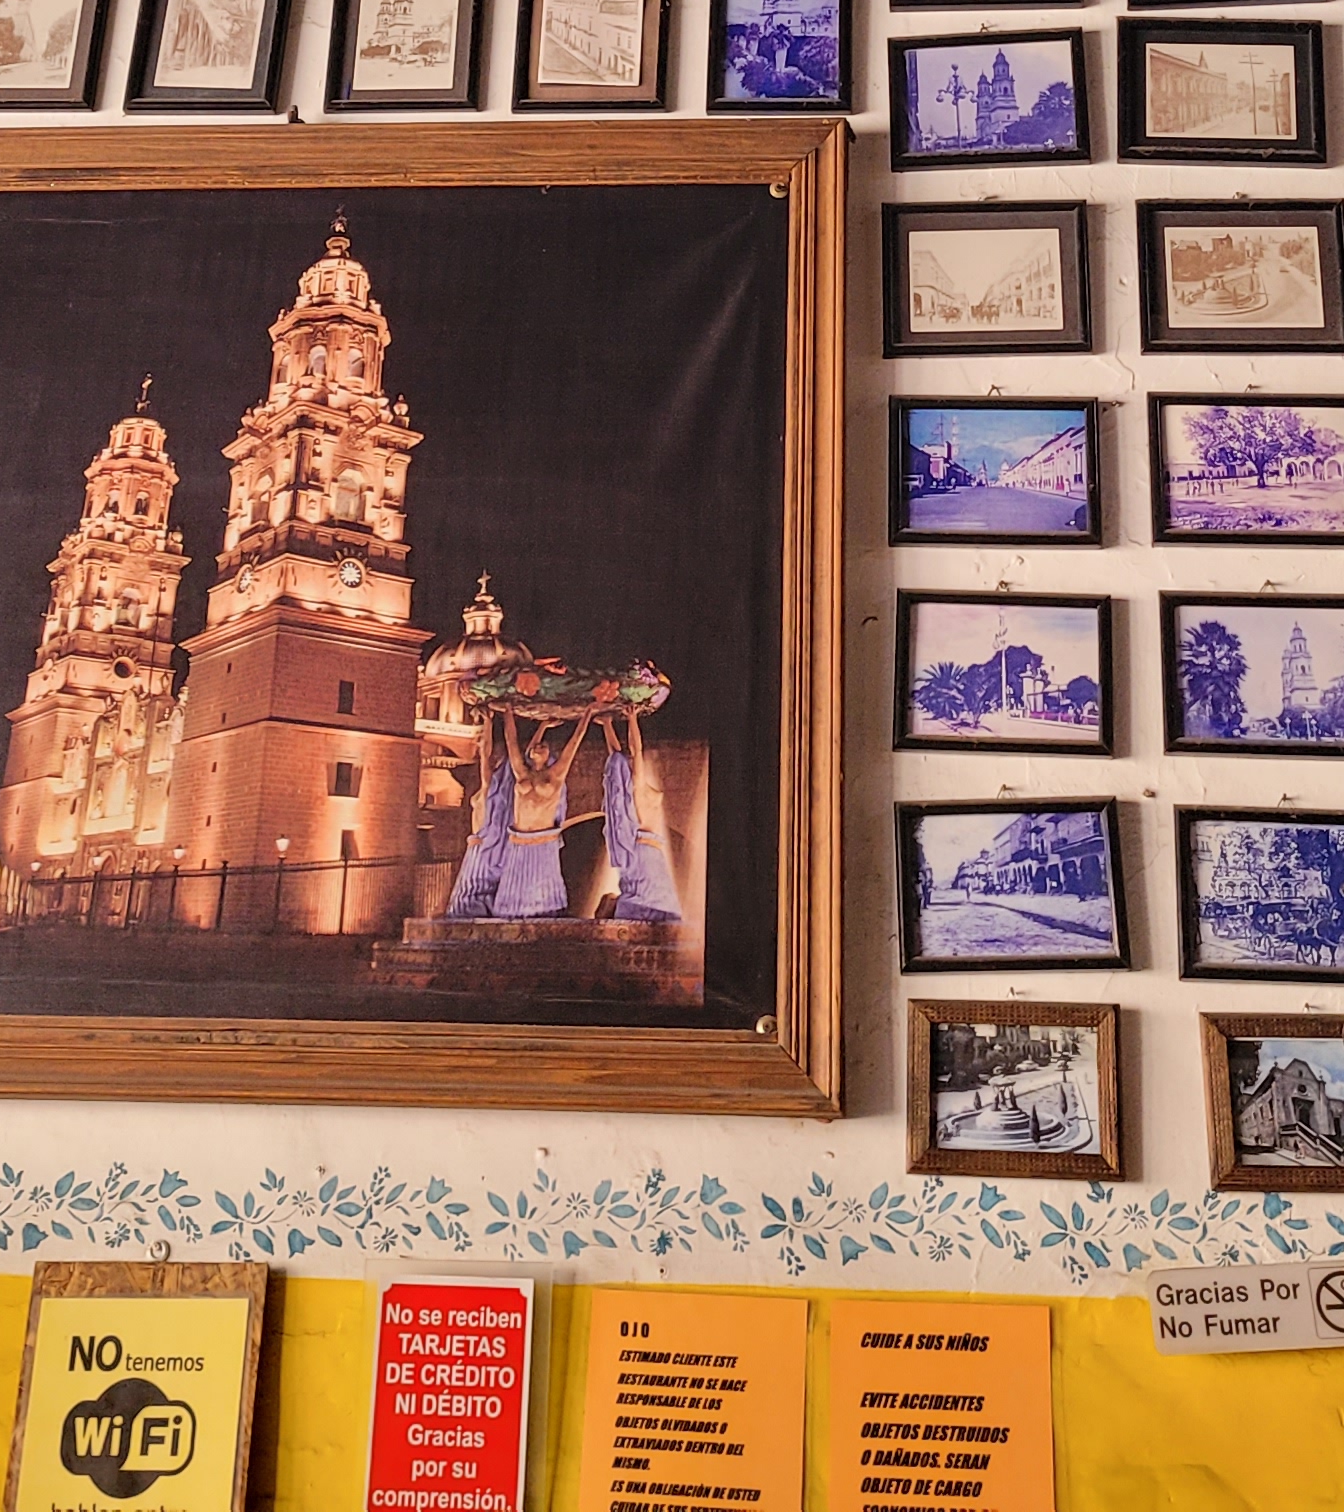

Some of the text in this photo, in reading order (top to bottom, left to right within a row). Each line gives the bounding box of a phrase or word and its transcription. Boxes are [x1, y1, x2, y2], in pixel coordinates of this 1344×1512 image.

[1156, 1279, 1300, 1306] Gracias Por
[385, 1303, 522, 1329] No se reciben
[1159, 1314, 1281, 1339] No Fumar
[398, 1333, 506, 1359] TARJETAS
[860, 1332, 990, 1352] CUIDE A SUS NIÑOS
[68, 1335, 205, 1372] NO tenemos
[619, 1350, 738, 1368] ESTIMADO CLIENTE ESTE
[385, 1359, 515, 1389] DE CRÉDITO
[617, 1373, 748, 1392] RESTAURANTE NO SE HACE
[395, 1389, 502, 1418] NI DÉBITO
[616, 1392, 723, 1411] RESPONSABLE DE LOS
[860, 1392, 985, 1412] EVITE ACCIDENTES
[407, 1423, 485, 1448] Gracias
[615, 1416, 728, 1434] OBJETOS OLVIDADOS O
[860, 1422, 1010, 1444] OBJETOS DESTRUIDOS
[613, 1436, 745, 1456] EXTRAVIADOS DENTRO DEL
[411, 1458, 477, 1481] por su
[611, 1456, 651, 1470] MISMO.
[860, 1447, 991, 1470] O DAÑADOS. SERAN
[610, 1480, 761, 1502] ES UNA OBLIGACIÓN DE USTED
[860, 1477, 983, 1498] OBJETO DE CARGO
